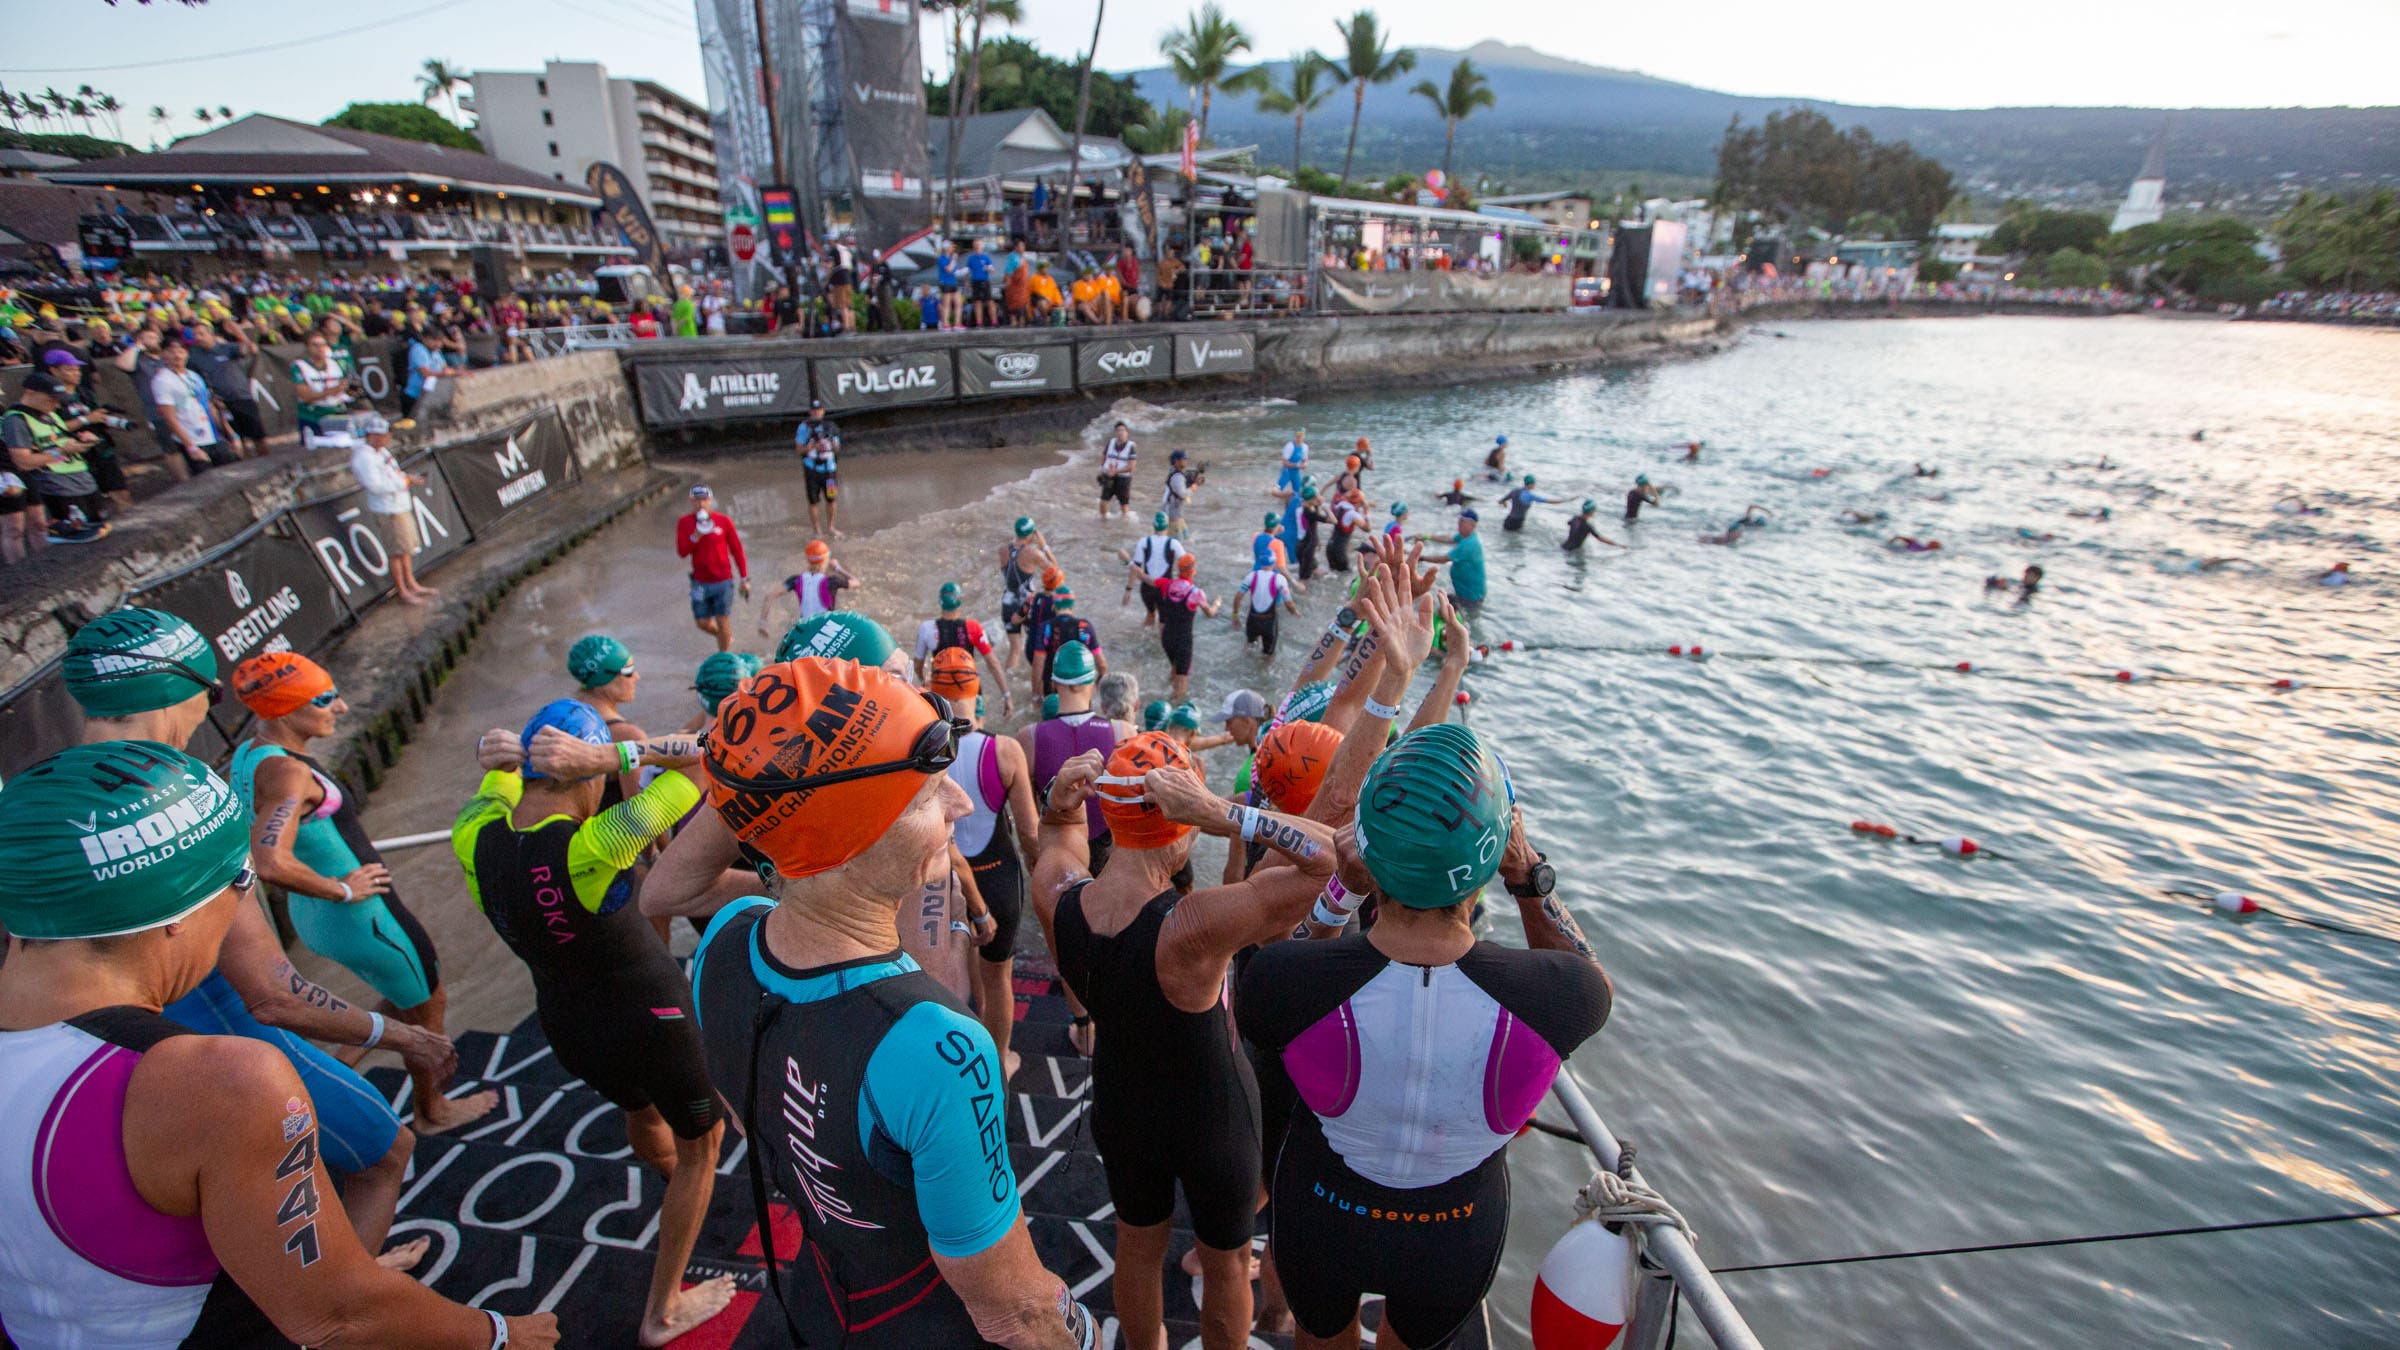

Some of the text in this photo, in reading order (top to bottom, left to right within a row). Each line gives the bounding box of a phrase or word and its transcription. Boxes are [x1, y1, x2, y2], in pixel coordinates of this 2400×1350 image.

[615, 204, 648, 246] VIP
[710, 372, 780, 394] ATHLETIC
[837, 364, 937, 396] FULGAZ
[722, 394, 760, 407] BREWING
[215, 585, 301, 663] BREITLING
[847, 744, 868, 767] Kona
[107, 783, 178, 820] VINFAST
[93, 845, 175, 881] WORLD
[935, 1030, 1010, 1203] SPAERO
[276, 1128, 321, 1269] 441
[1312, 1182, 1475, 1223] blueseventy
